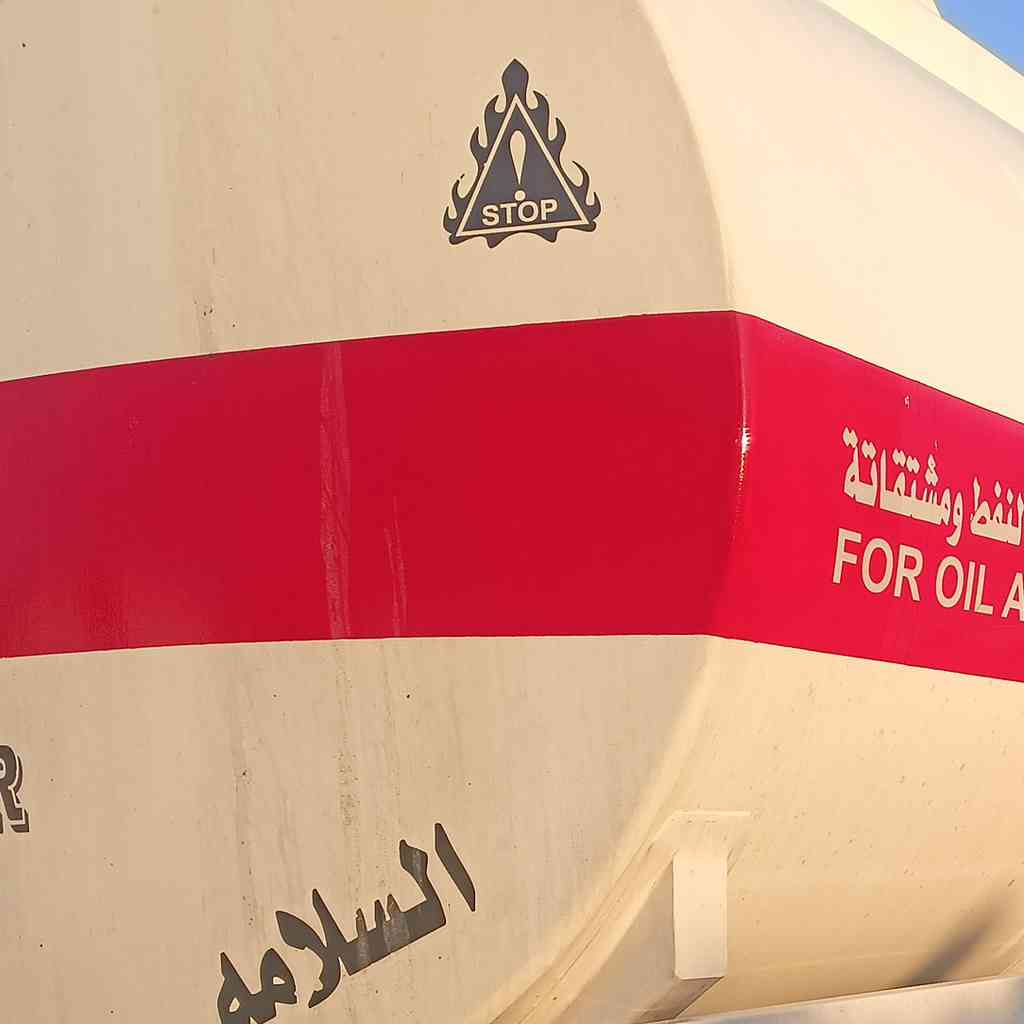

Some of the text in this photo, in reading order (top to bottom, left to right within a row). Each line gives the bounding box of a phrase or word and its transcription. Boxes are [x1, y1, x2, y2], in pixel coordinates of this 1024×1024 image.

[481, 198, 558, 227] STOP
[832, 527, 924, 601] FOR
[935, 555, 994, 616] OIL
